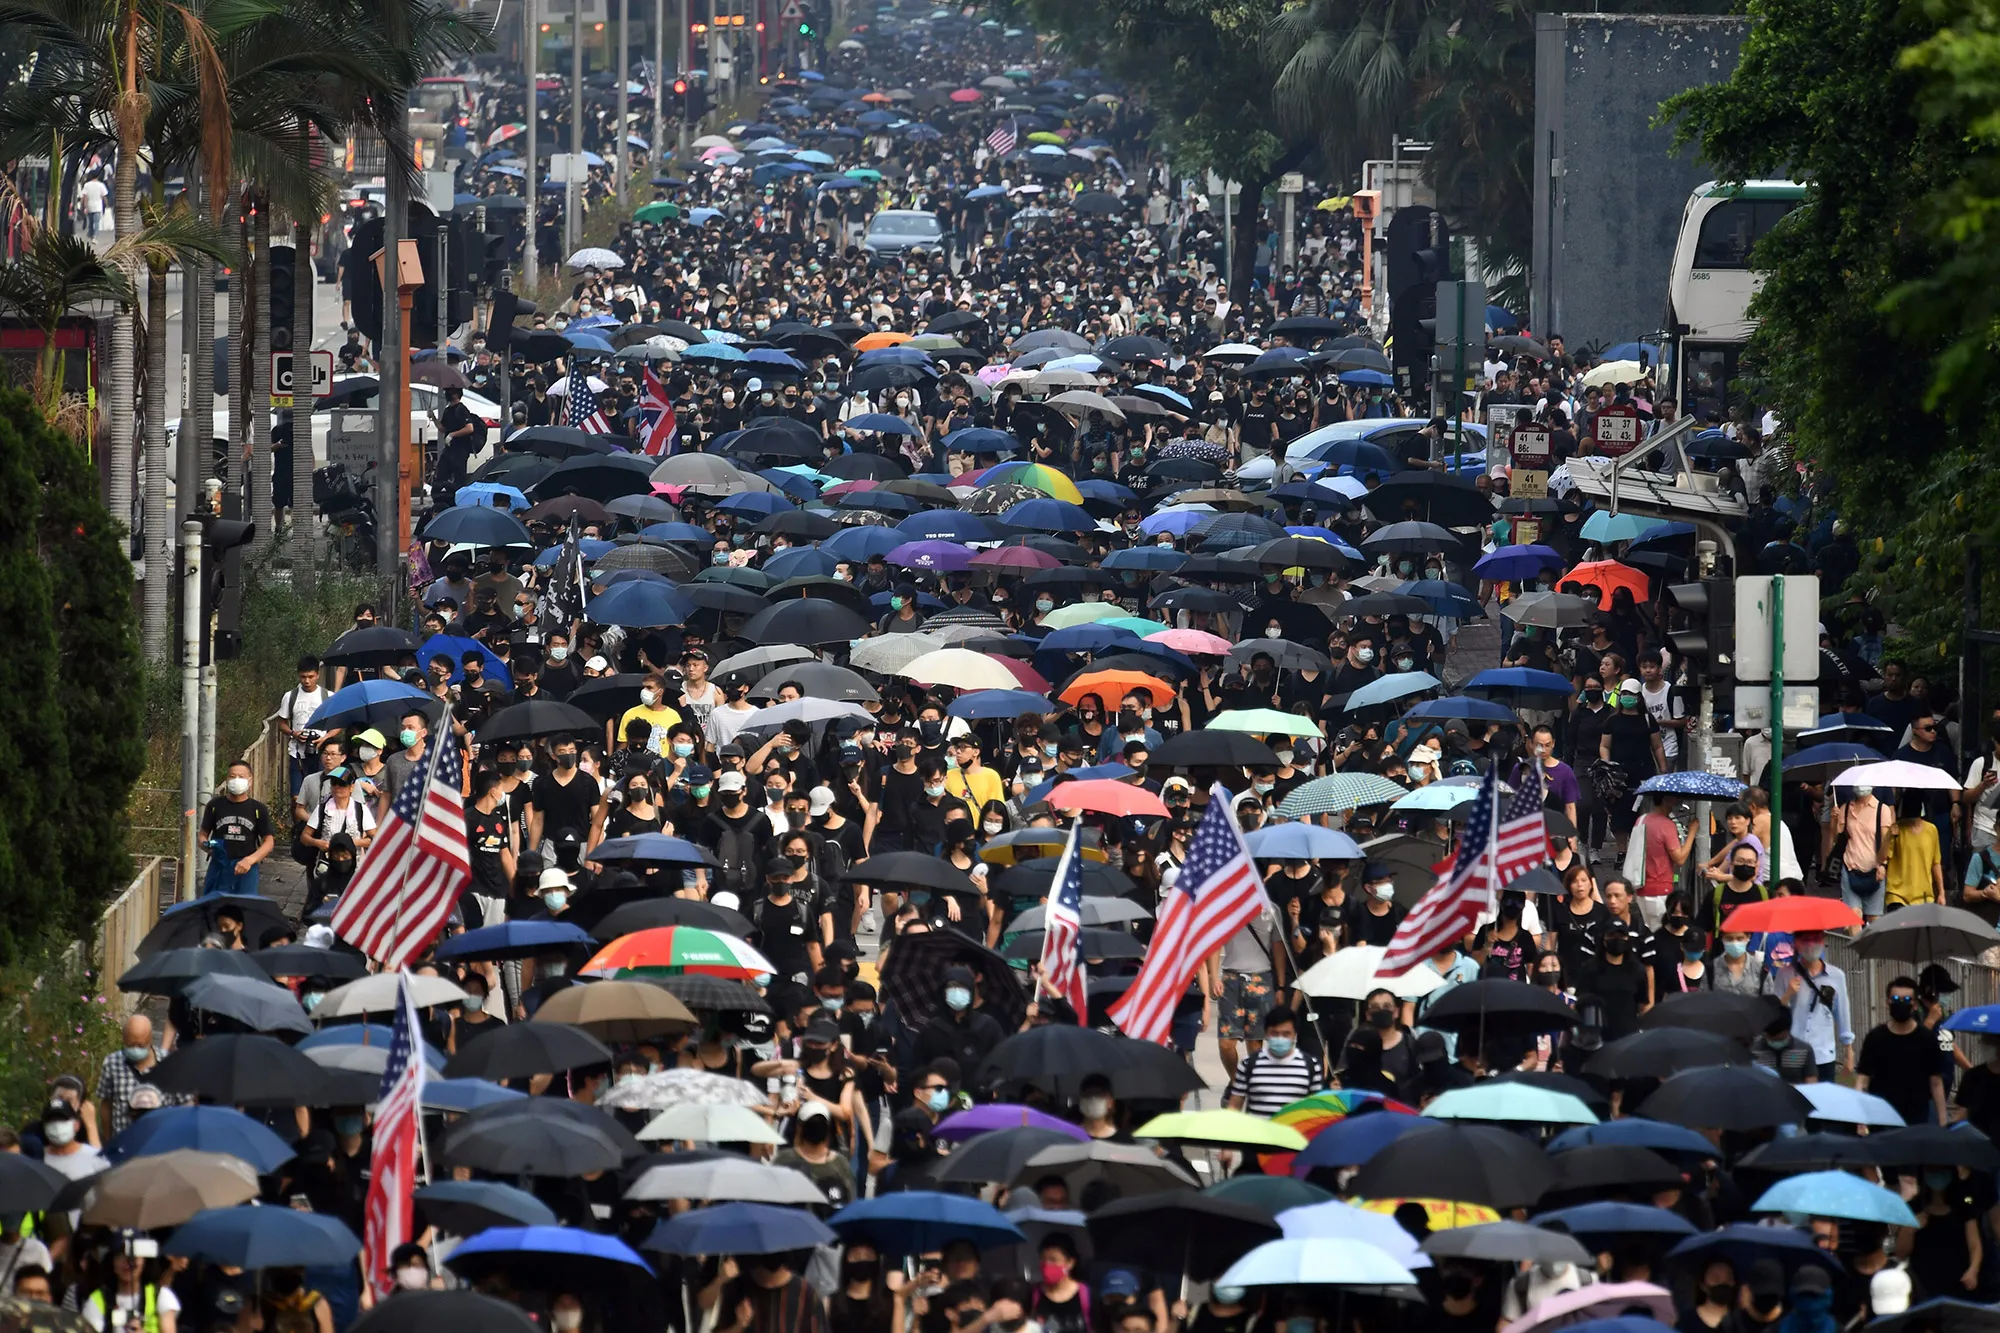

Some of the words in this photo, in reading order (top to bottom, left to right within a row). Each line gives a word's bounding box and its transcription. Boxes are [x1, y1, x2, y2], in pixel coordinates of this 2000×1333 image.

[1622, 419, 1631, 429] 37
[1519, 433, 1528, 442] 41
[1535, 433, 1545, 442] 44
[1525, 474, 1534, 483] 41
